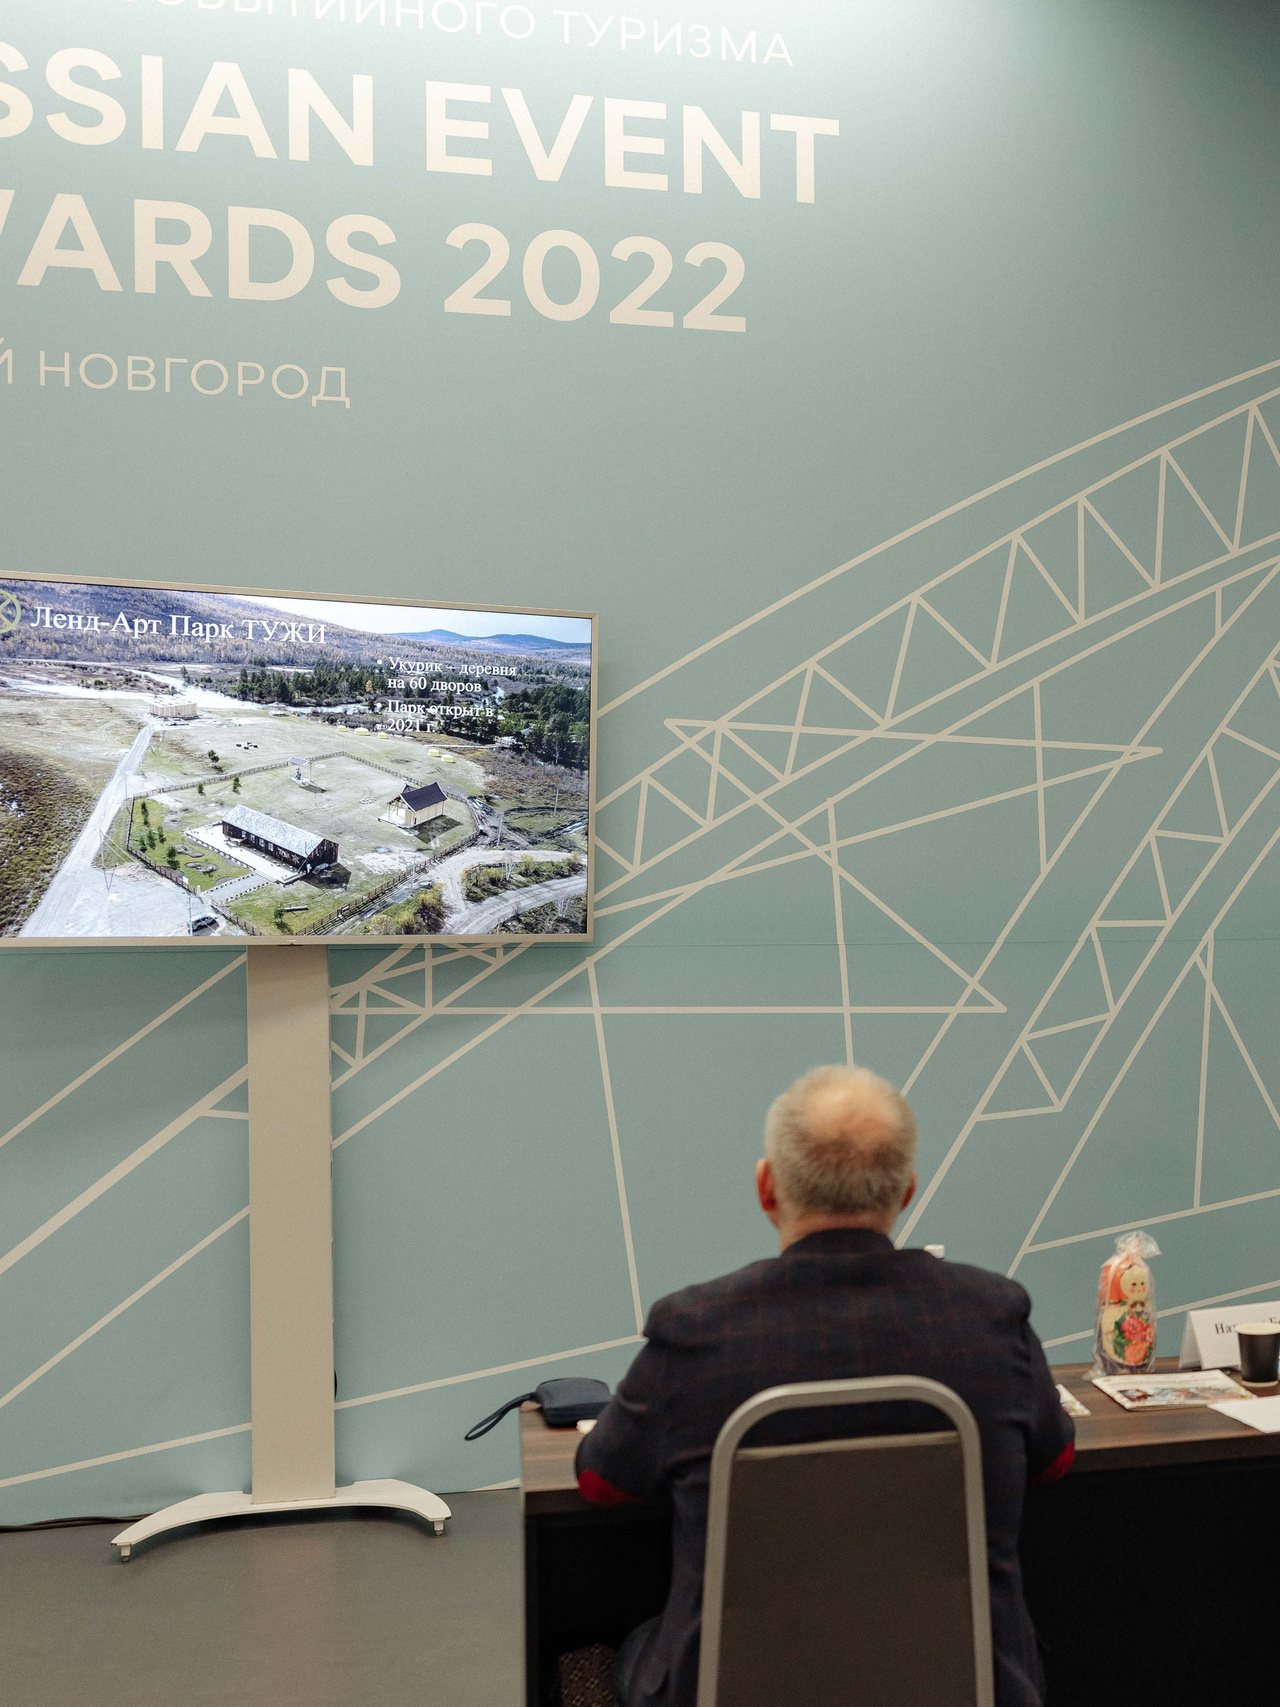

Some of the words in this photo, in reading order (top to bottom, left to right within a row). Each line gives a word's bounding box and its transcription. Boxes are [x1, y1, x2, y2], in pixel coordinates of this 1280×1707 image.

[552, 9, 794, 67] ТУРИЗМА
[425, 80, 840, 204] EVENT
[0, 188, 401, 309] ARDS
[443, 222, 747, 333] 2022
[39, 350, 351, 409] НОВГОРОД
[30, 606, 162, 640] Ленд-Арт
[169, 614, 234, 643] Парк
[242, 619, 327, 645] ТУЖИ
[387, 678, 405, 689] на
[409, 676, 427, 690] 60
[430, 681, 482, 694] дворов
[388, 656, 442, 674] Укурик
[459, 664, 517, 678] деревня
[387, 718, 421, 732] 2021
[426, 722, 436, 733] г.
[388, 700, 426, 715] Парк
[429, 705, 483, 719] открыт
[486, 708, 494, 717] в
